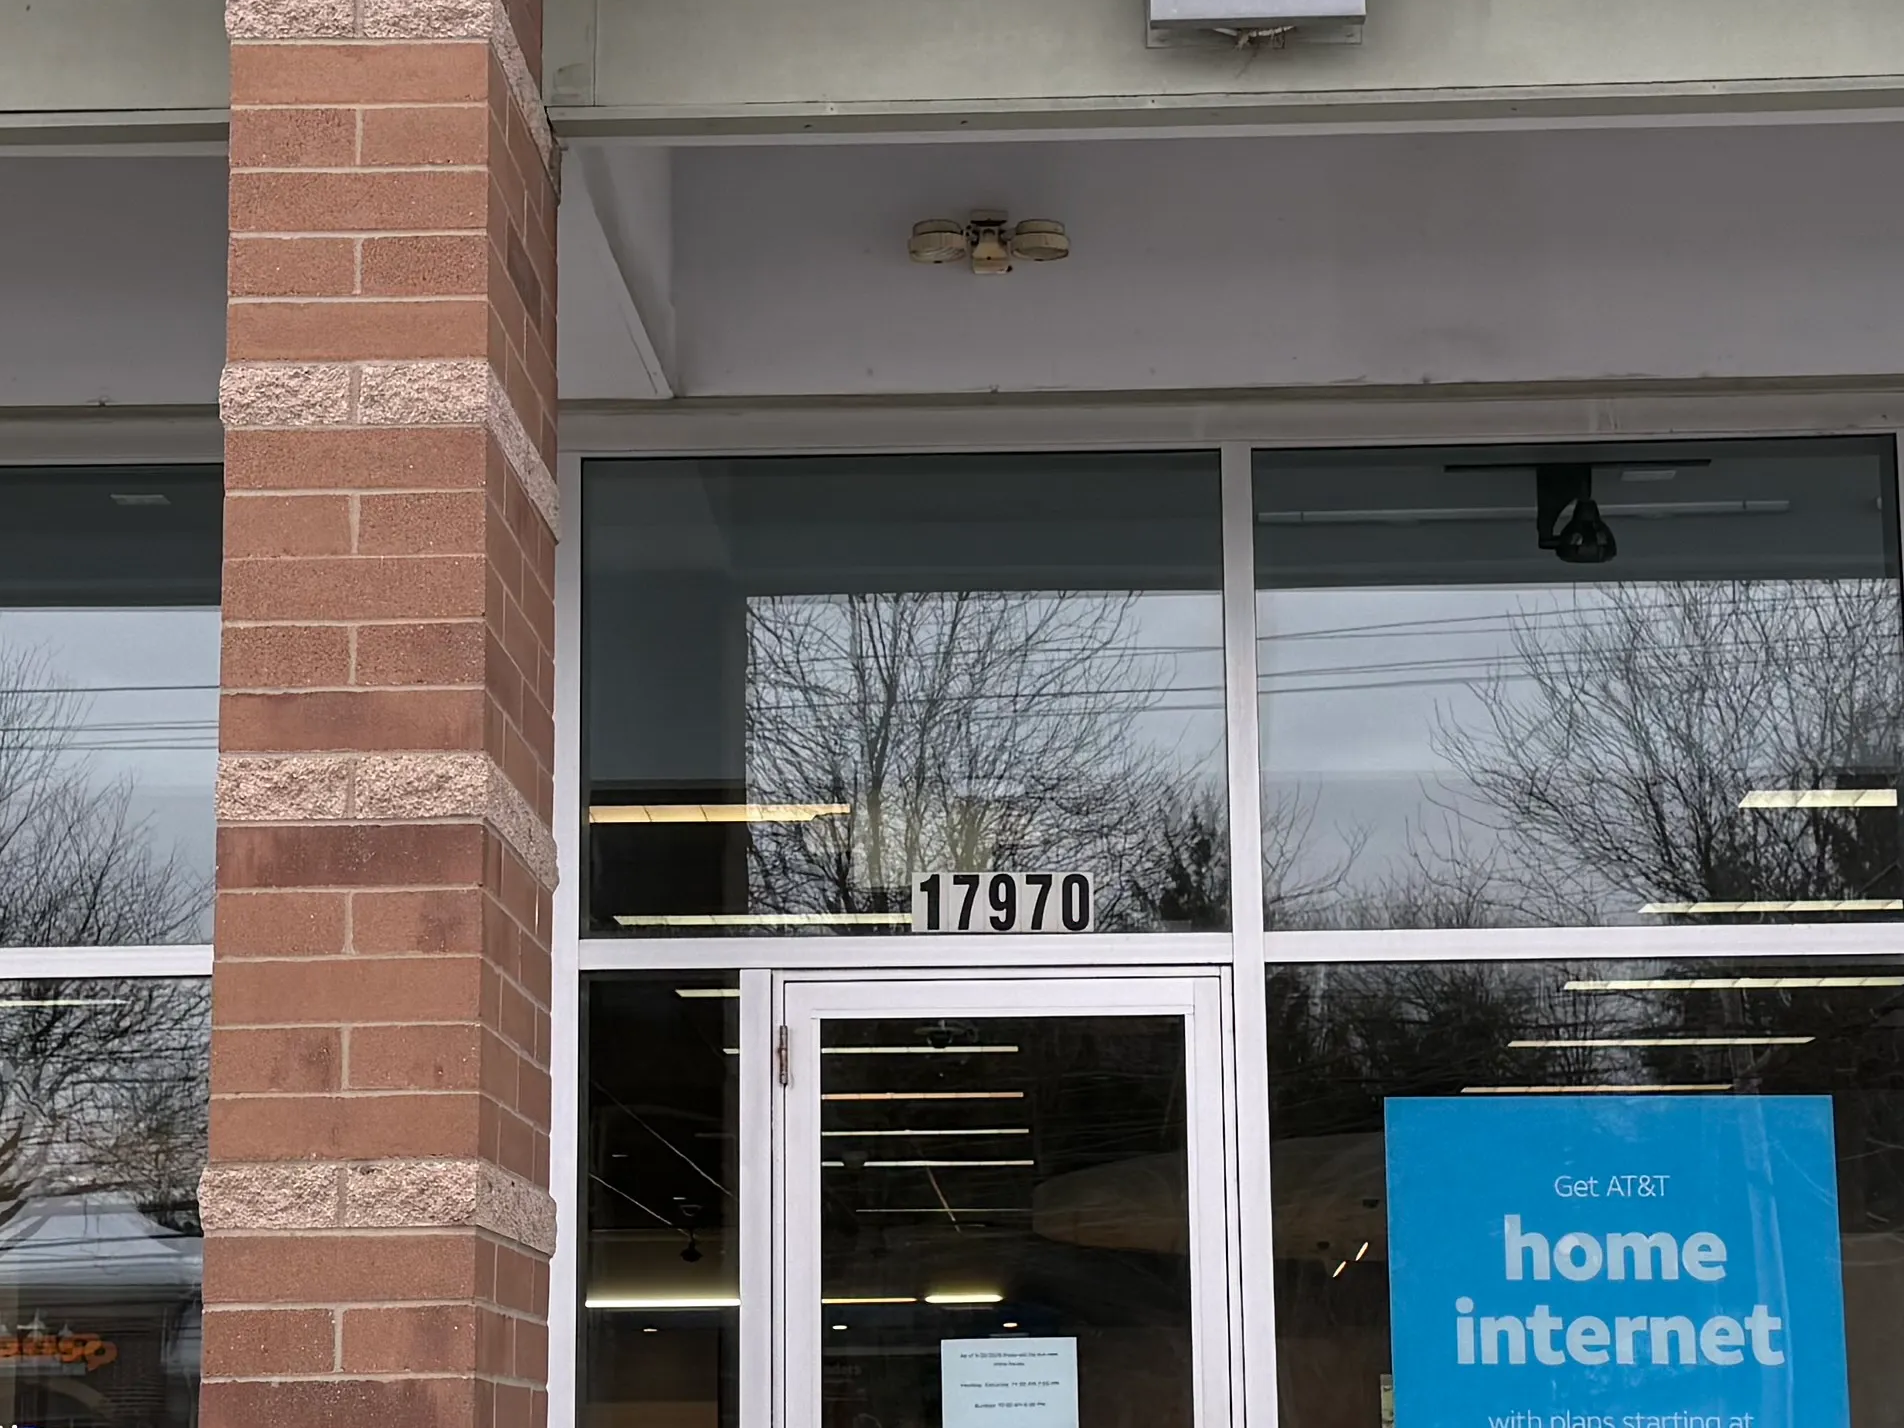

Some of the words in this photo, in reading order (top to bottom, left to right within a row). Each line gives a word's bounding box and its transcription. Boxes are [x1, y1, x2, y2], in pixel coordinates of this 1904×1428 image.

[919, 873, 1090, 932] 17970
[1554, 1174, 1600, 1198] Get
[1606, 1174, 1670, 1198] AT&T
[1504, 1213, 1727, 1282] home
[1455, 1296, 1786, 1366] internet
